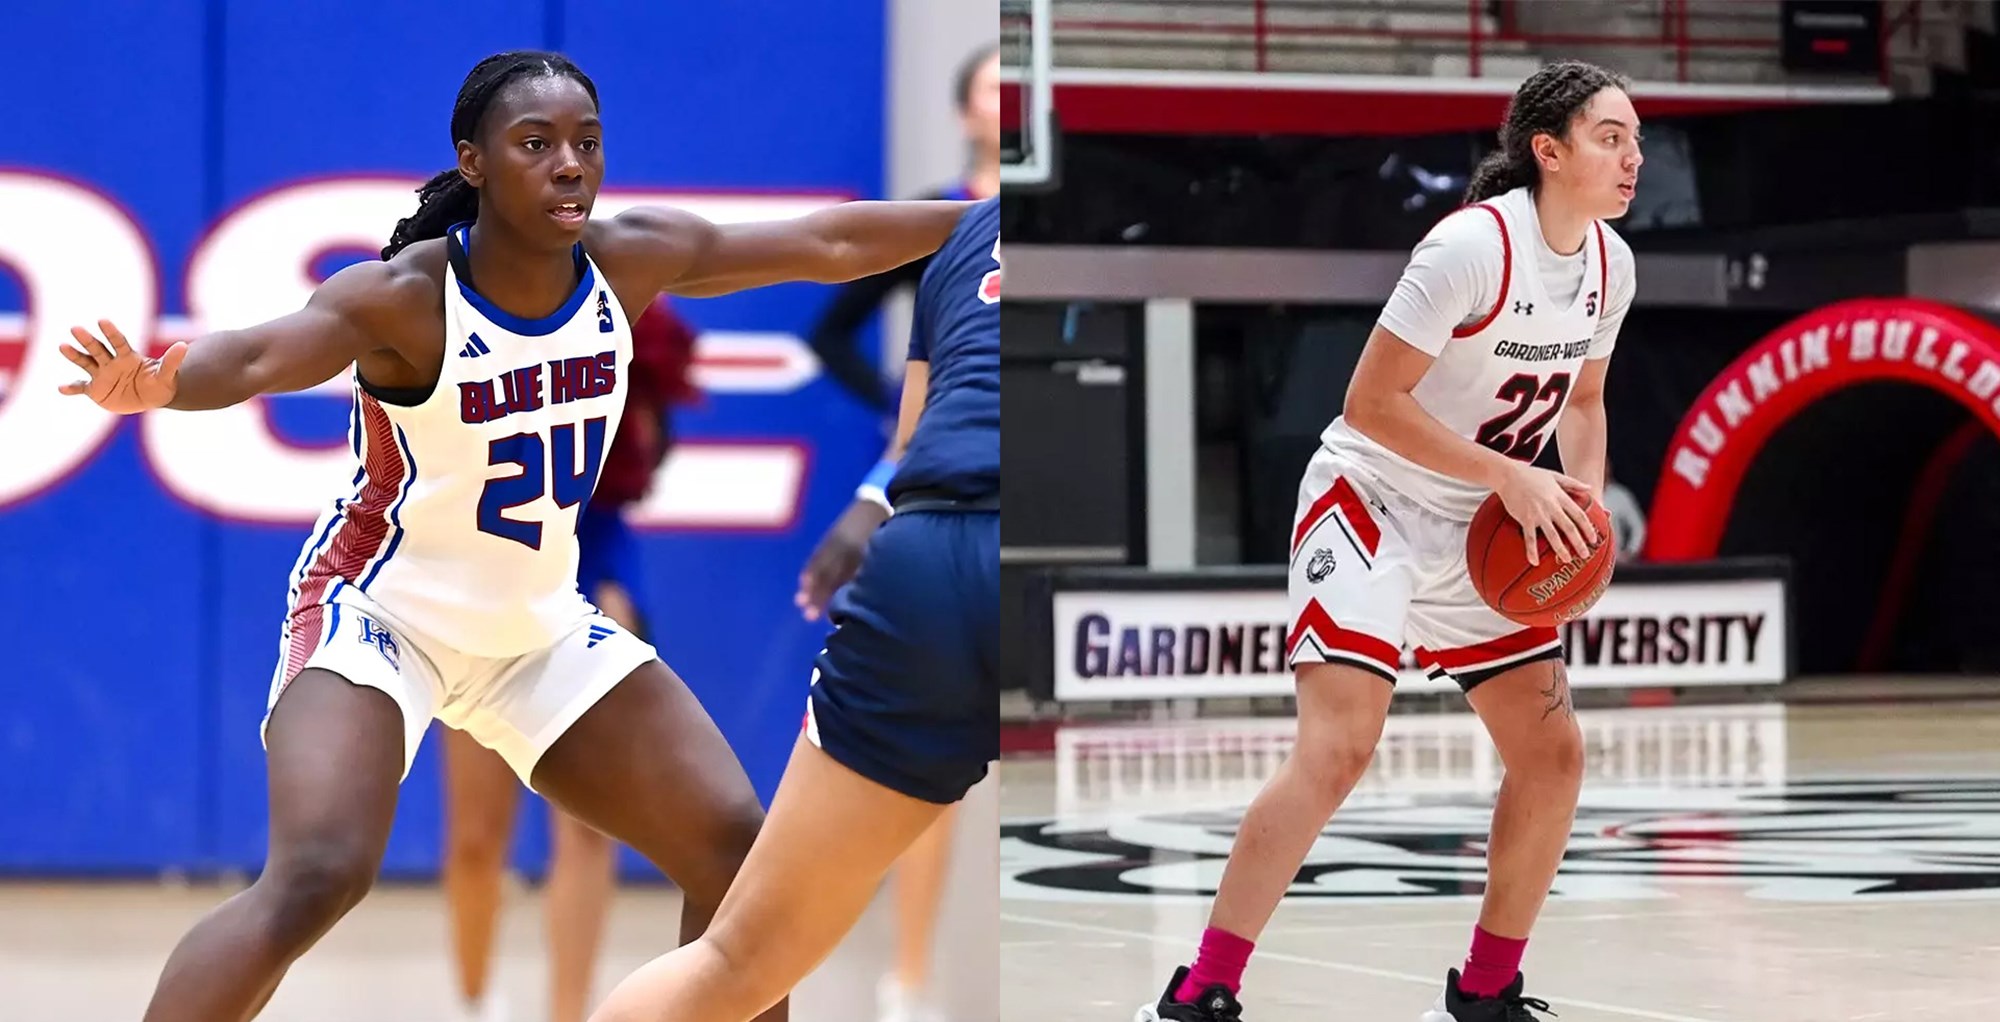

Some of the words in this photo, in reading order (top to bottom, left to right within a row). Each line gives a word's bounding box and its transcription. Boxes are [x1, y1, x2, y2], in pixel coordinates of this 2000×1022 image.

[457, 363, 544, 424] BLUE
[1850, 319, 2000, 421] BULLD
[1474, 372, 1571, 463] 22
[477, 415, 607, 551] 24
[1527, 531, 1606, 606] SPALDG
